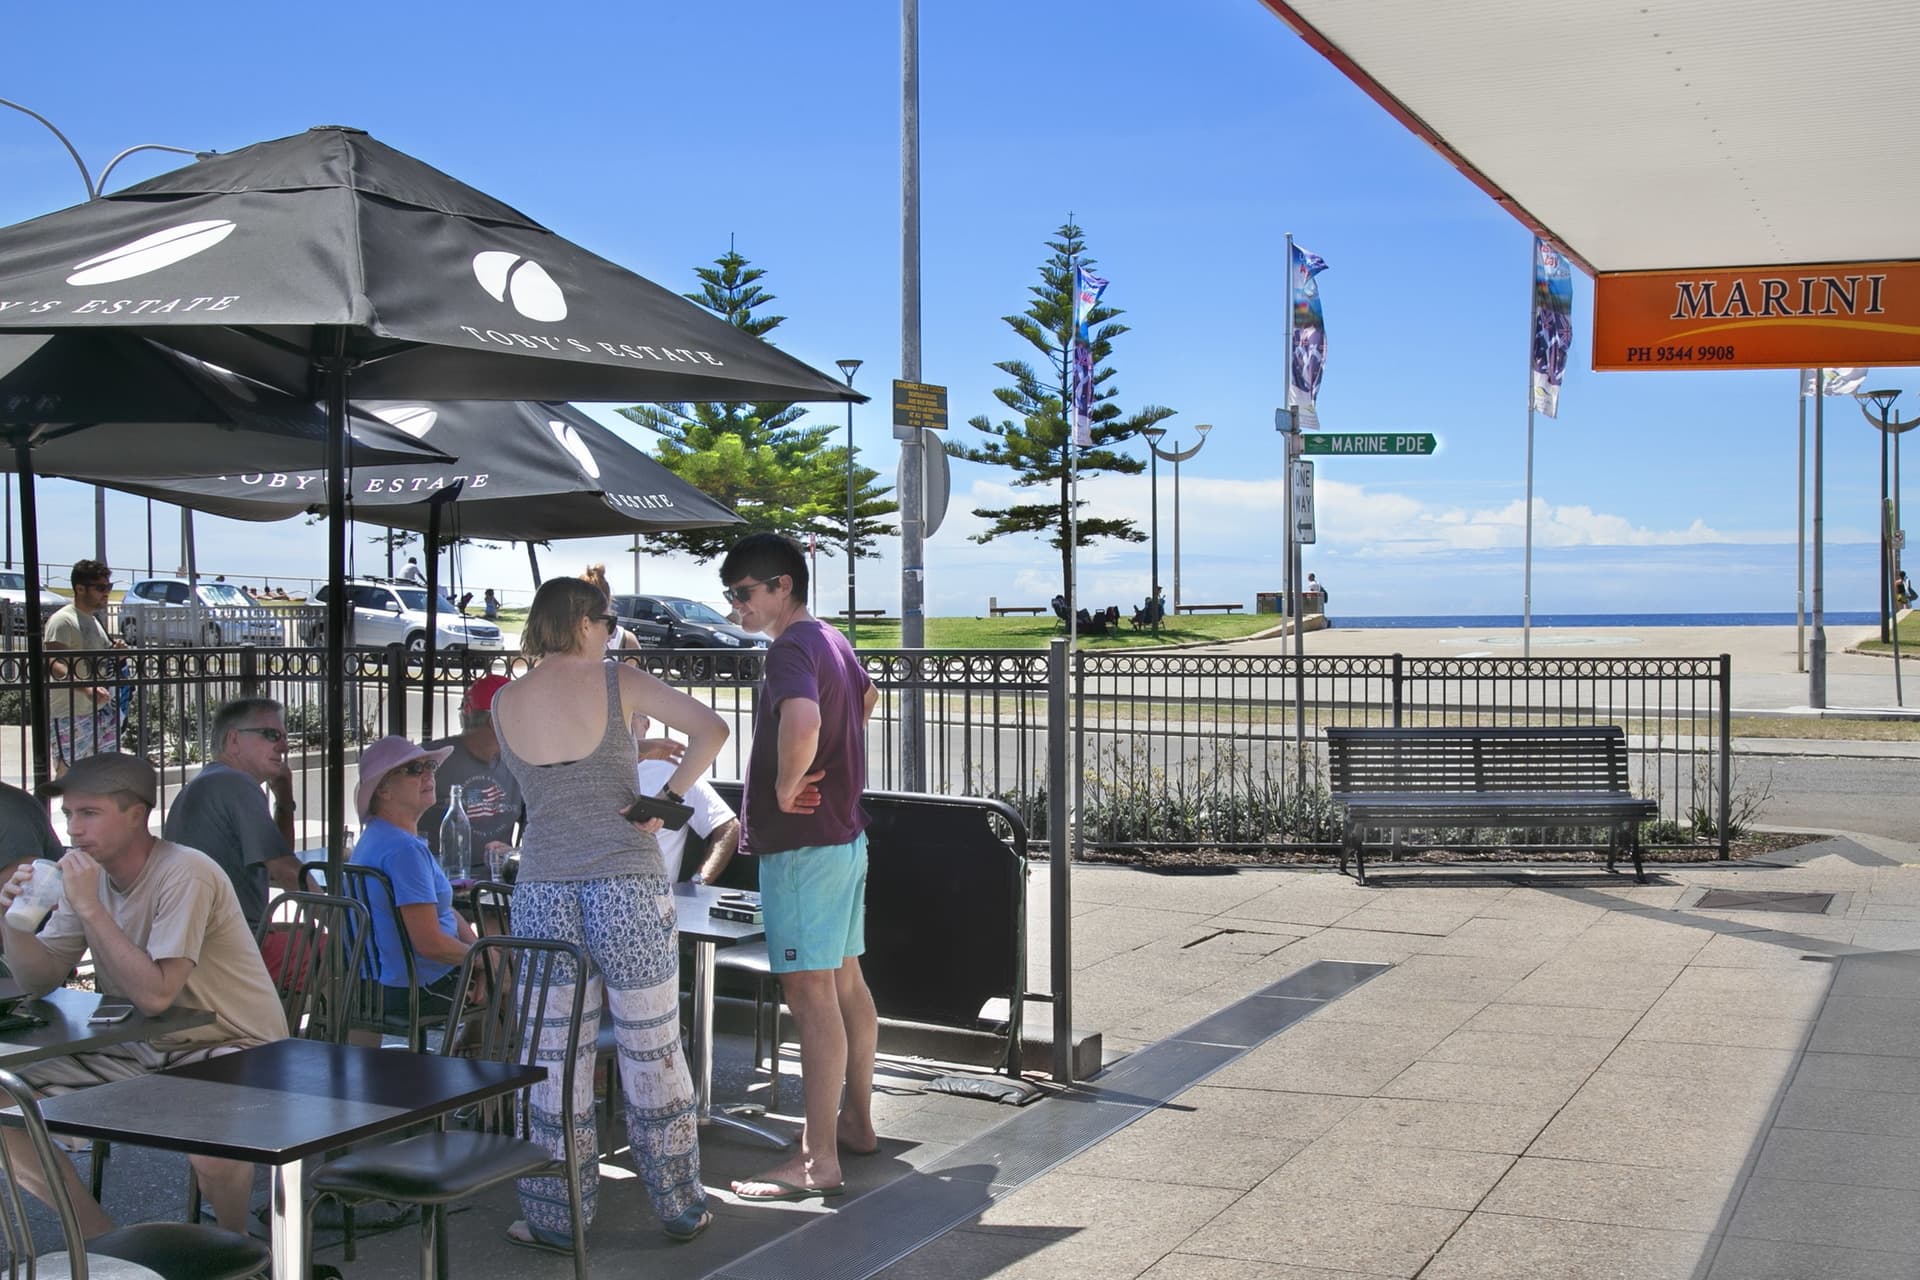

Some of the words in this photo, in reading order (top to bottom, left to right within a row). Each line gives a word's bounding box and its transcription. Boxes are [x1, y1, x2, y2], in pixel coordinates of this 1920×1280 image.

[72, 295, 240, 314] ESTATE
[1670, 274, 1887, 320] MARINI
[460, 325, 592, 354] TOBY'S
[597, 341, 724, 367] ESTATE
[1626, 347, 1651, 362] PH
[1656, 346, 1693, 361] 9344
[1697, 345, 1735, 361] 9908
[1331, 436, 1388, 452] MARINE
[1396, 436, 1426, 452] PDE
[1295, 469, 1311, 488] ONE
[1295, 495, 1312, 513] WAY
